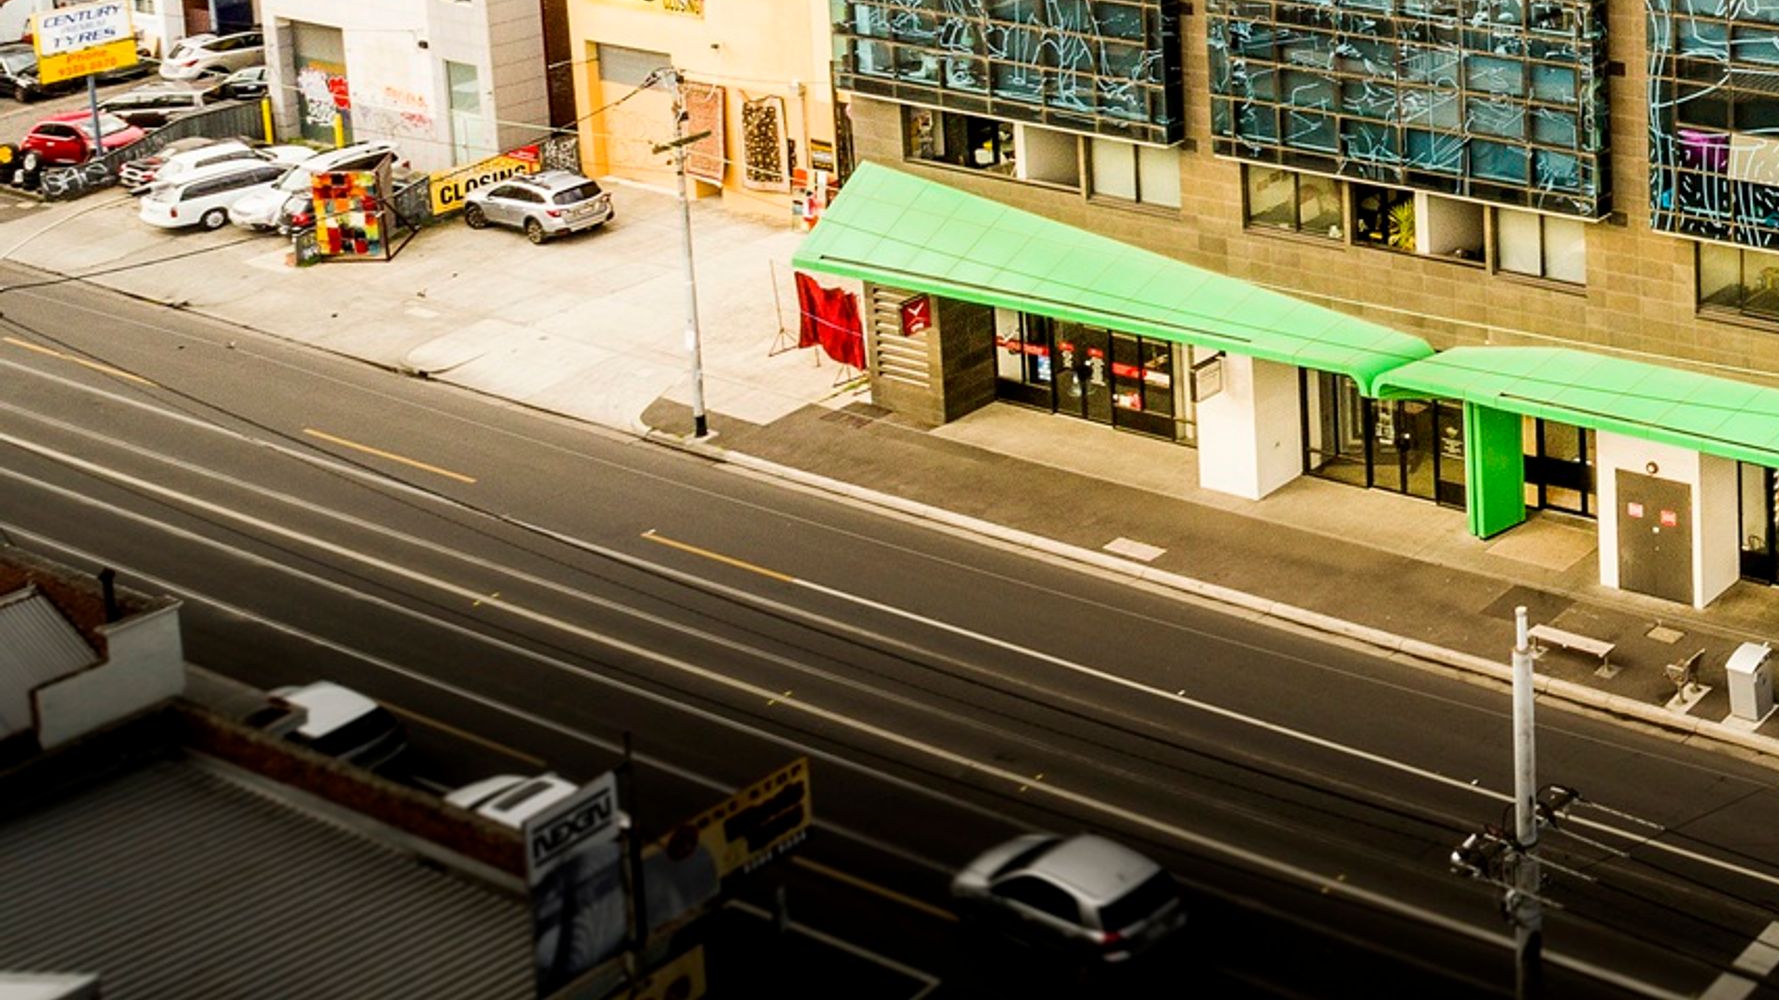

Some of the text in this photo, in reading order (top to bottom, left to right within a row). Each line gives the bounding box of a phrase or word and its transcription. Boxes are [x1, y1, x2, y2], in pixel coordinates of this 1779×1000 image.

[43, 4, 121, 28] CENTURY
[54, 27, 116, 48] TYRES
[532, 796, 613, 859] NEXEN
